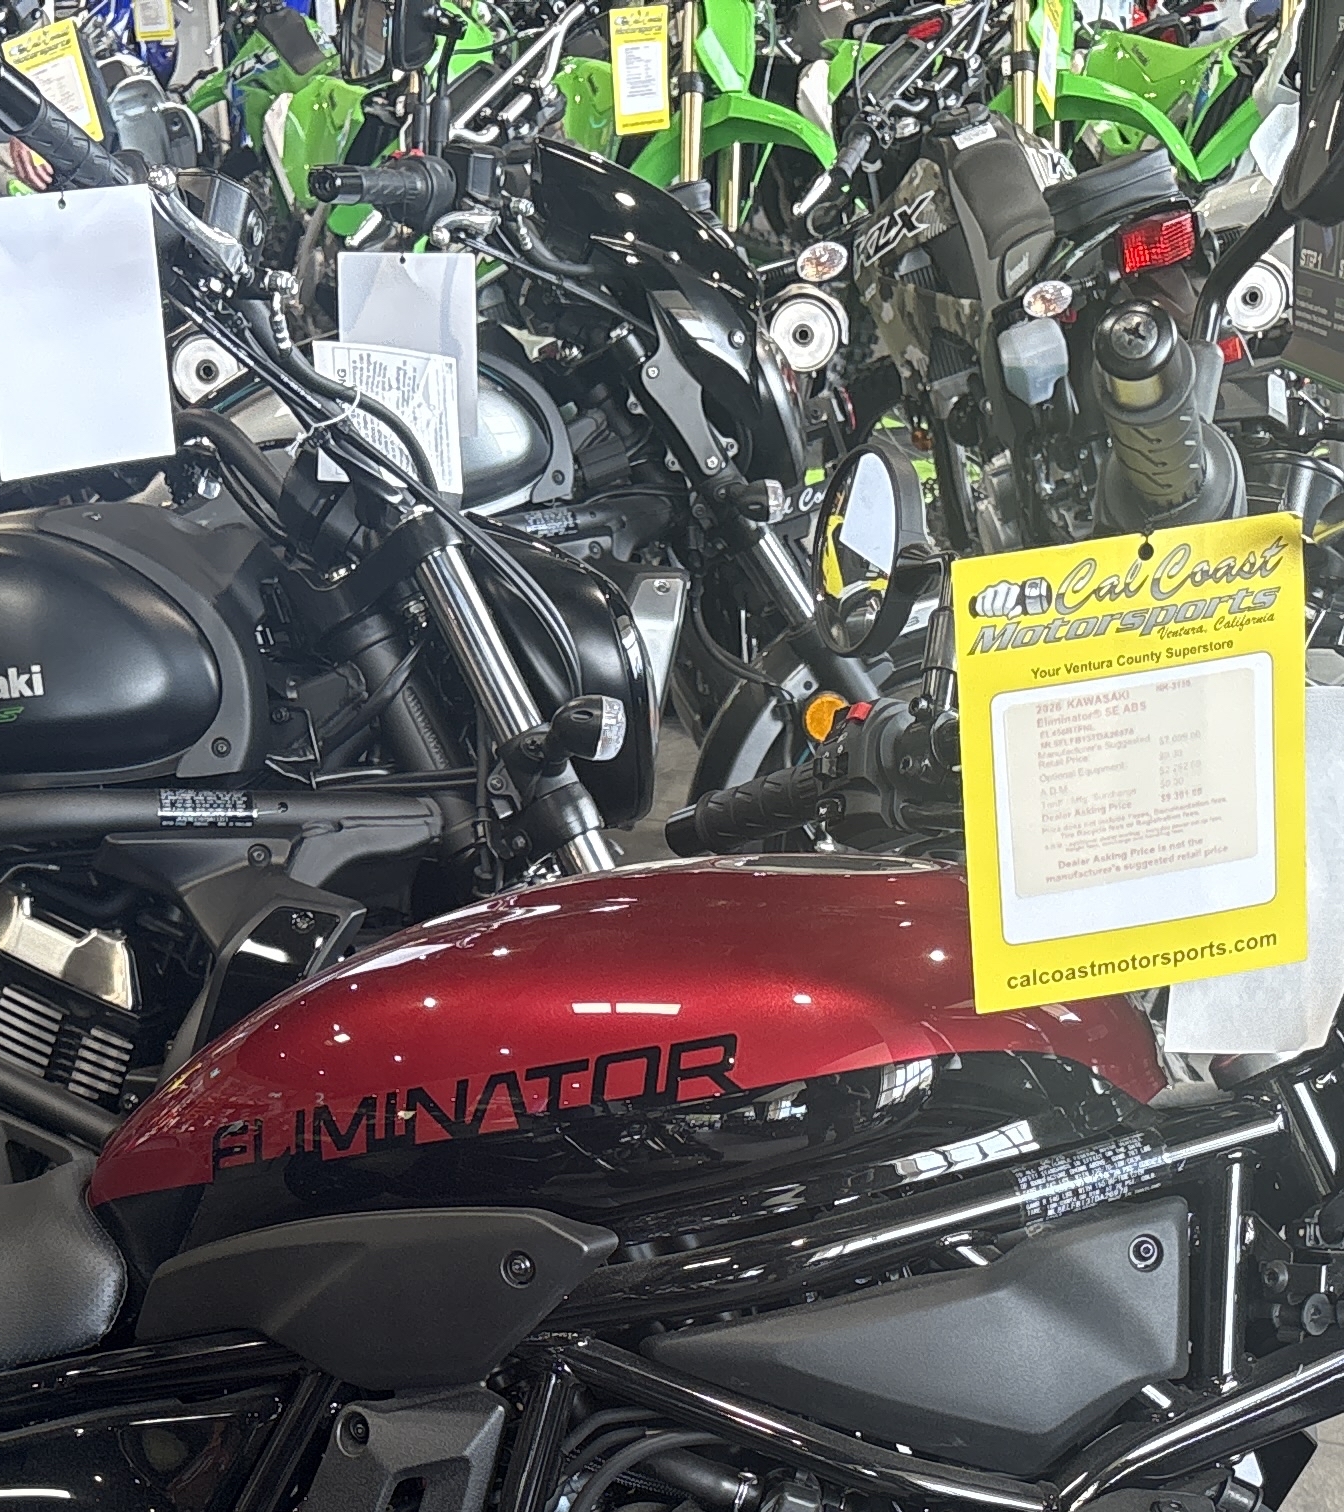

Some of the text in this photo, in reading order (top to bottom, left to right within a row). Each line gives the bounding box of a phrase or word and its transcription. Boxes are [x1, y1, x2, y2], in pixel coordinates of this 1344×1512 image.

[1056, 535, 1288, 615] Cal Coast
[967, 586, 1281, 656] Motorsports
[1213, 612, 1276, 632] California
[1031, 639, 1234, 680] Your Ventura County Superstore
[1067, 690, 1130, 709] KAWASAKI
[1058, 858, 1090, 869] Dealer
[1093, 851, 1128, 864] Asking
[1130, 847, 1156, 858] Price
[1123, 854, 1174, 870] suggested
[1204, 845, 1228, 858] price
[1006, 932, 1277, 990] calcoastmotorsports.com
